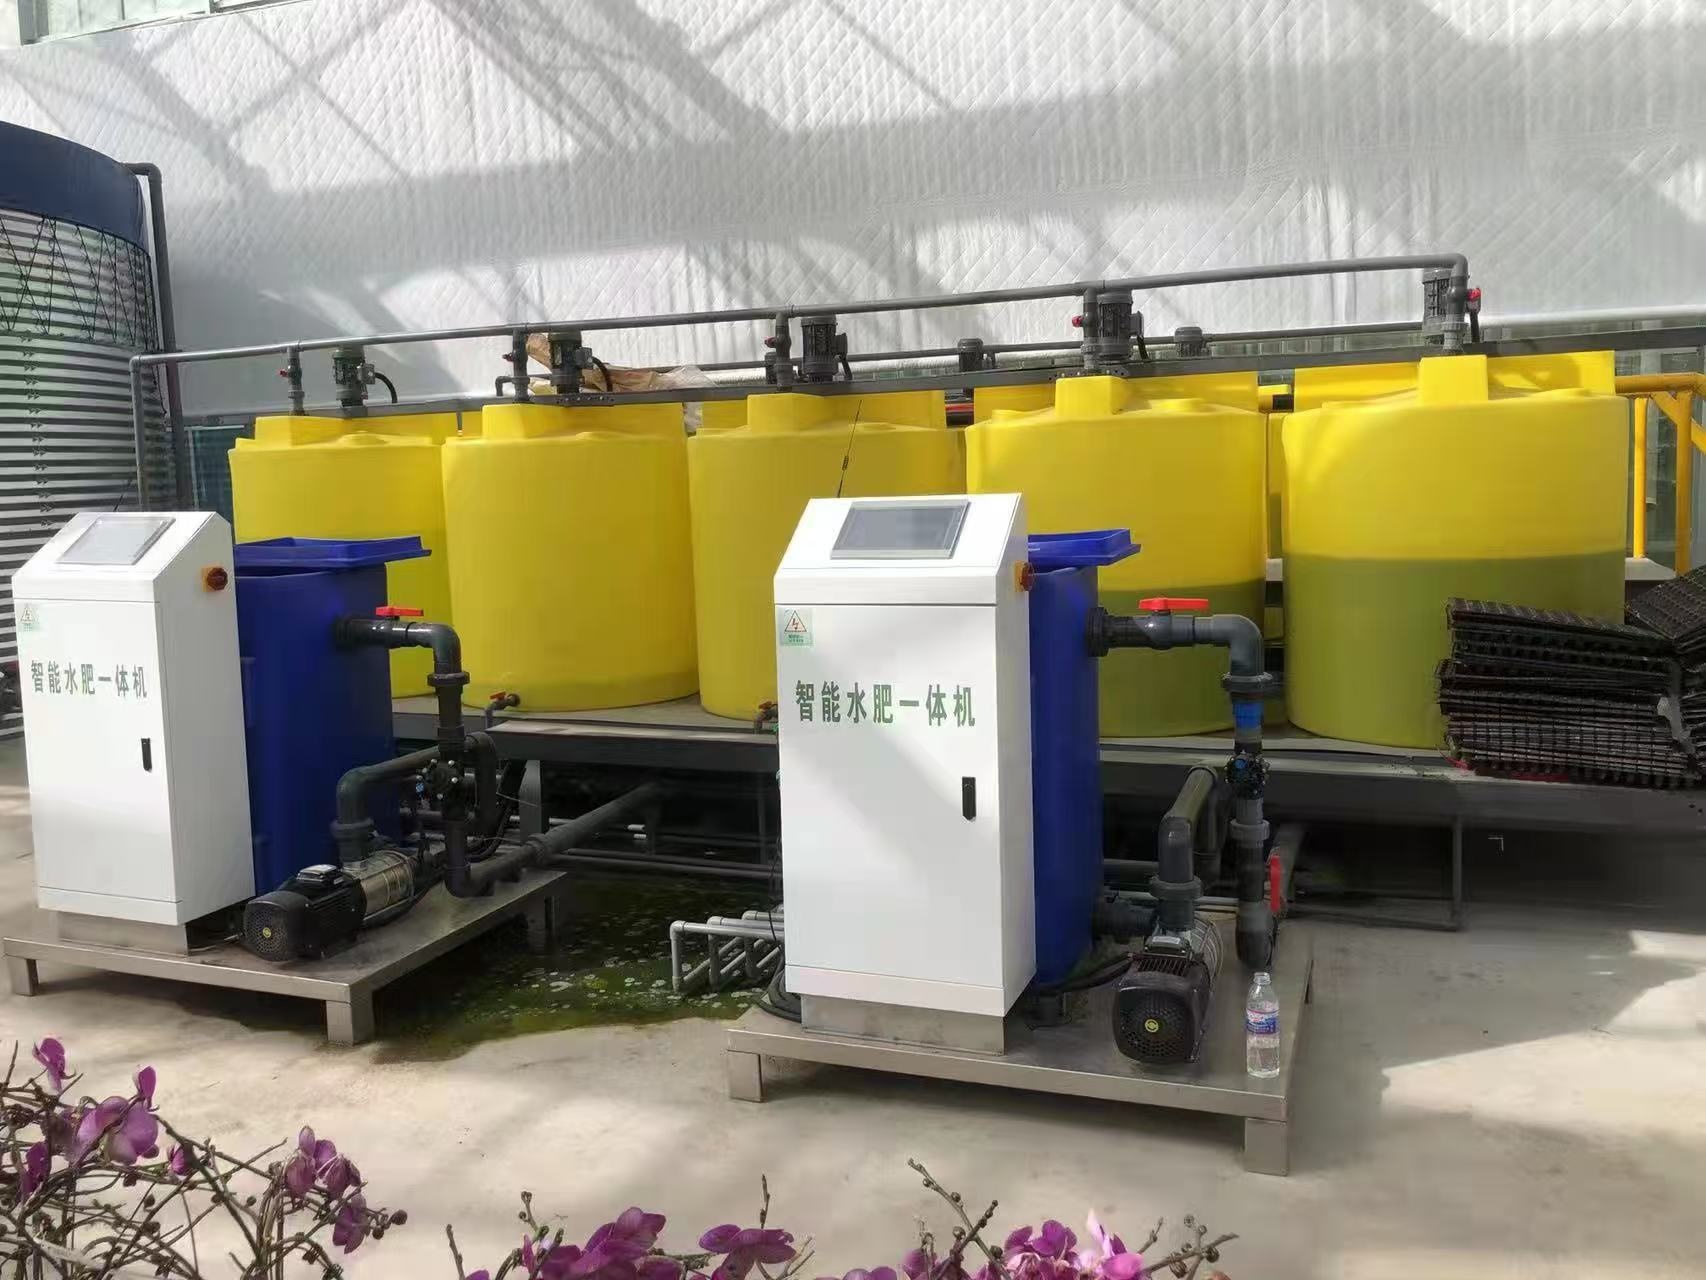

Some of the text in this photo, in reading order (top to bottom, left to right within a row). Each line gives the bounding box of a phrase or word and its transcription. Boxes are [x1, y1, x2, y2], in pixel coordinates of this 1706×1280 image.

[31, 660, 147, 698] 智能水肥一体机
[795, 680, 975, 727] 智能水肥一体机
